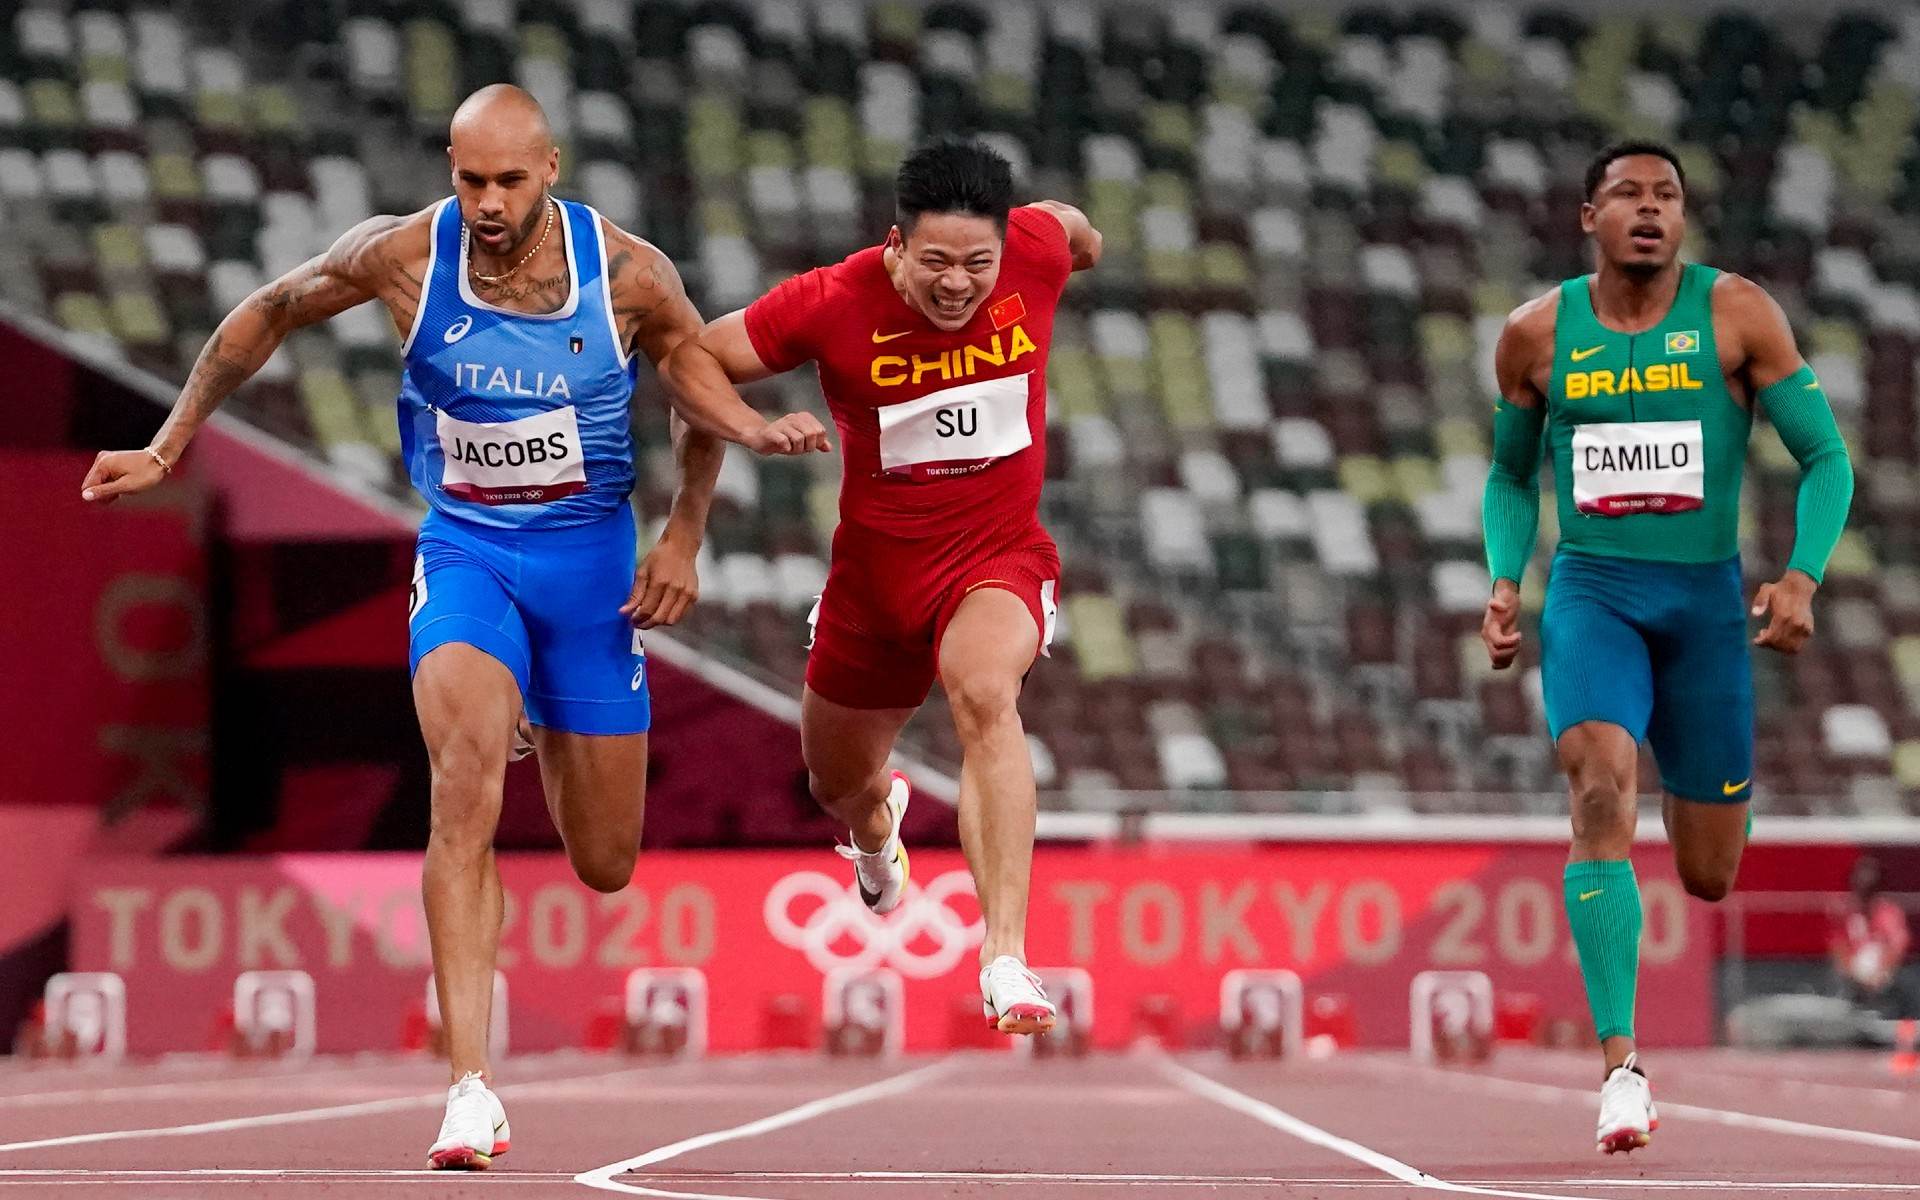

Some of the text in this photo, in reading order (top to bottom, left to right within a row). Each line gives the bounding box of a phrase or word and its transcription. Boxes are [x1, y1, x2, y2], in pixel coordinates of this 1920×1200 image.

[871, 325, 1037, 387] CHINA
[455, 362, 571, 399] ITALIA
[1565, 362, 1703, 400] BRASIL
[935, 407, 977, 438] SU
[451, 432, 568, 468] JACOBS
[1585, 442, 1689, 472] CAMILO
[926, 467, 968, 476] TOKYO 2020
[1609, 499, 1646, 509] TOKYO 2020
[94, 882, 428, 970] TOKYO
[1053, 880, 1689, 966] TOKYO 200
